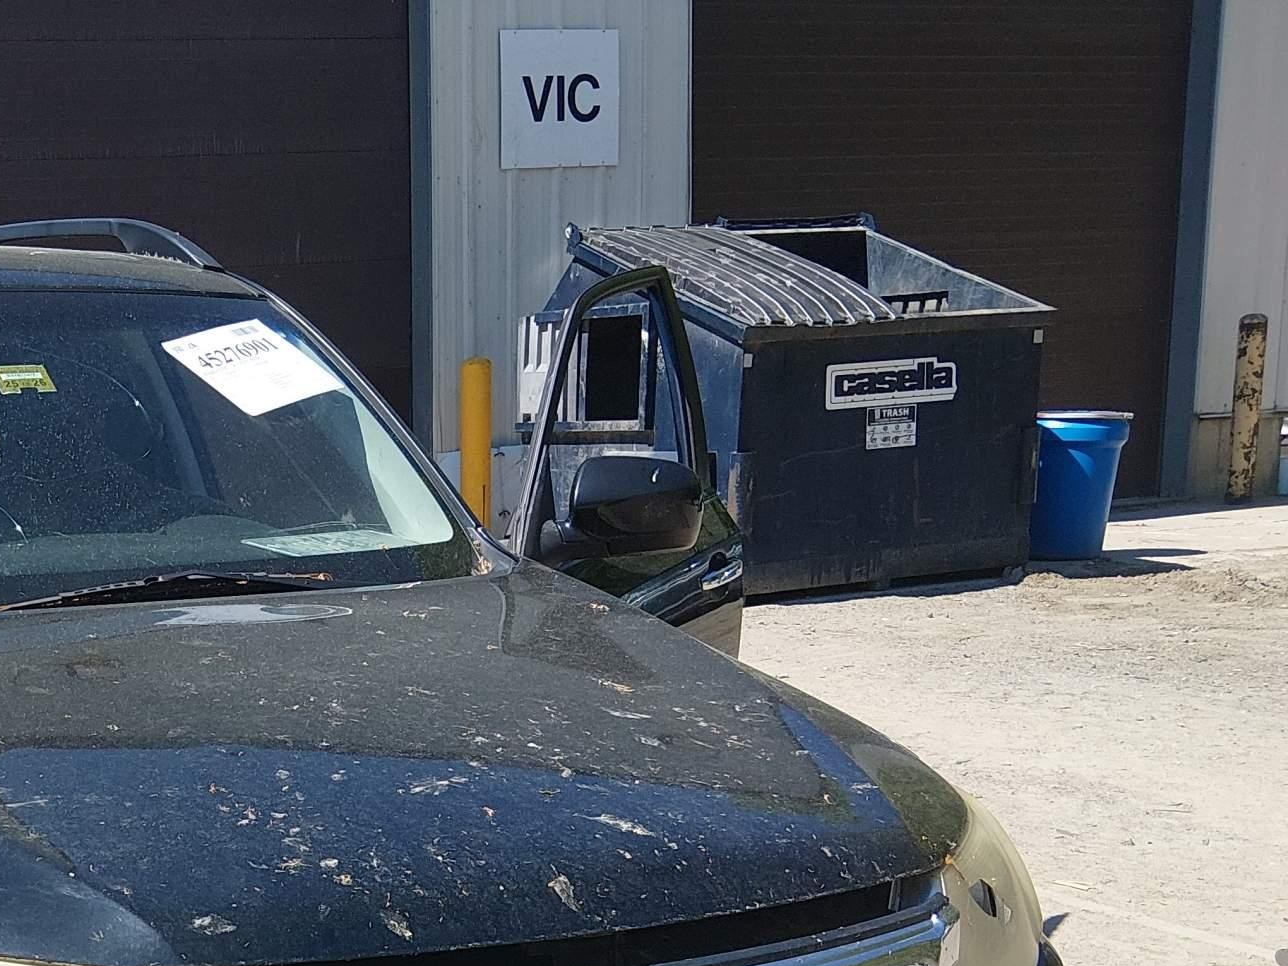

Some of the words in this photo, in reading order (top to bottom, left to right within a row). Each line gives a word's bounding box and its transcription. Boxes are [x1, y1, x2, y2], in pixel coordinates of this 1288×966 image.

[521, 73, 601, 123] VIC
[197, 337, 279, 369] 45276901
[4, 380, 19, 388] 25
[33, 378, 47, 387] 26
[834, 360, 954, 398] casella
[882, 407, 910, 418] TRASH
